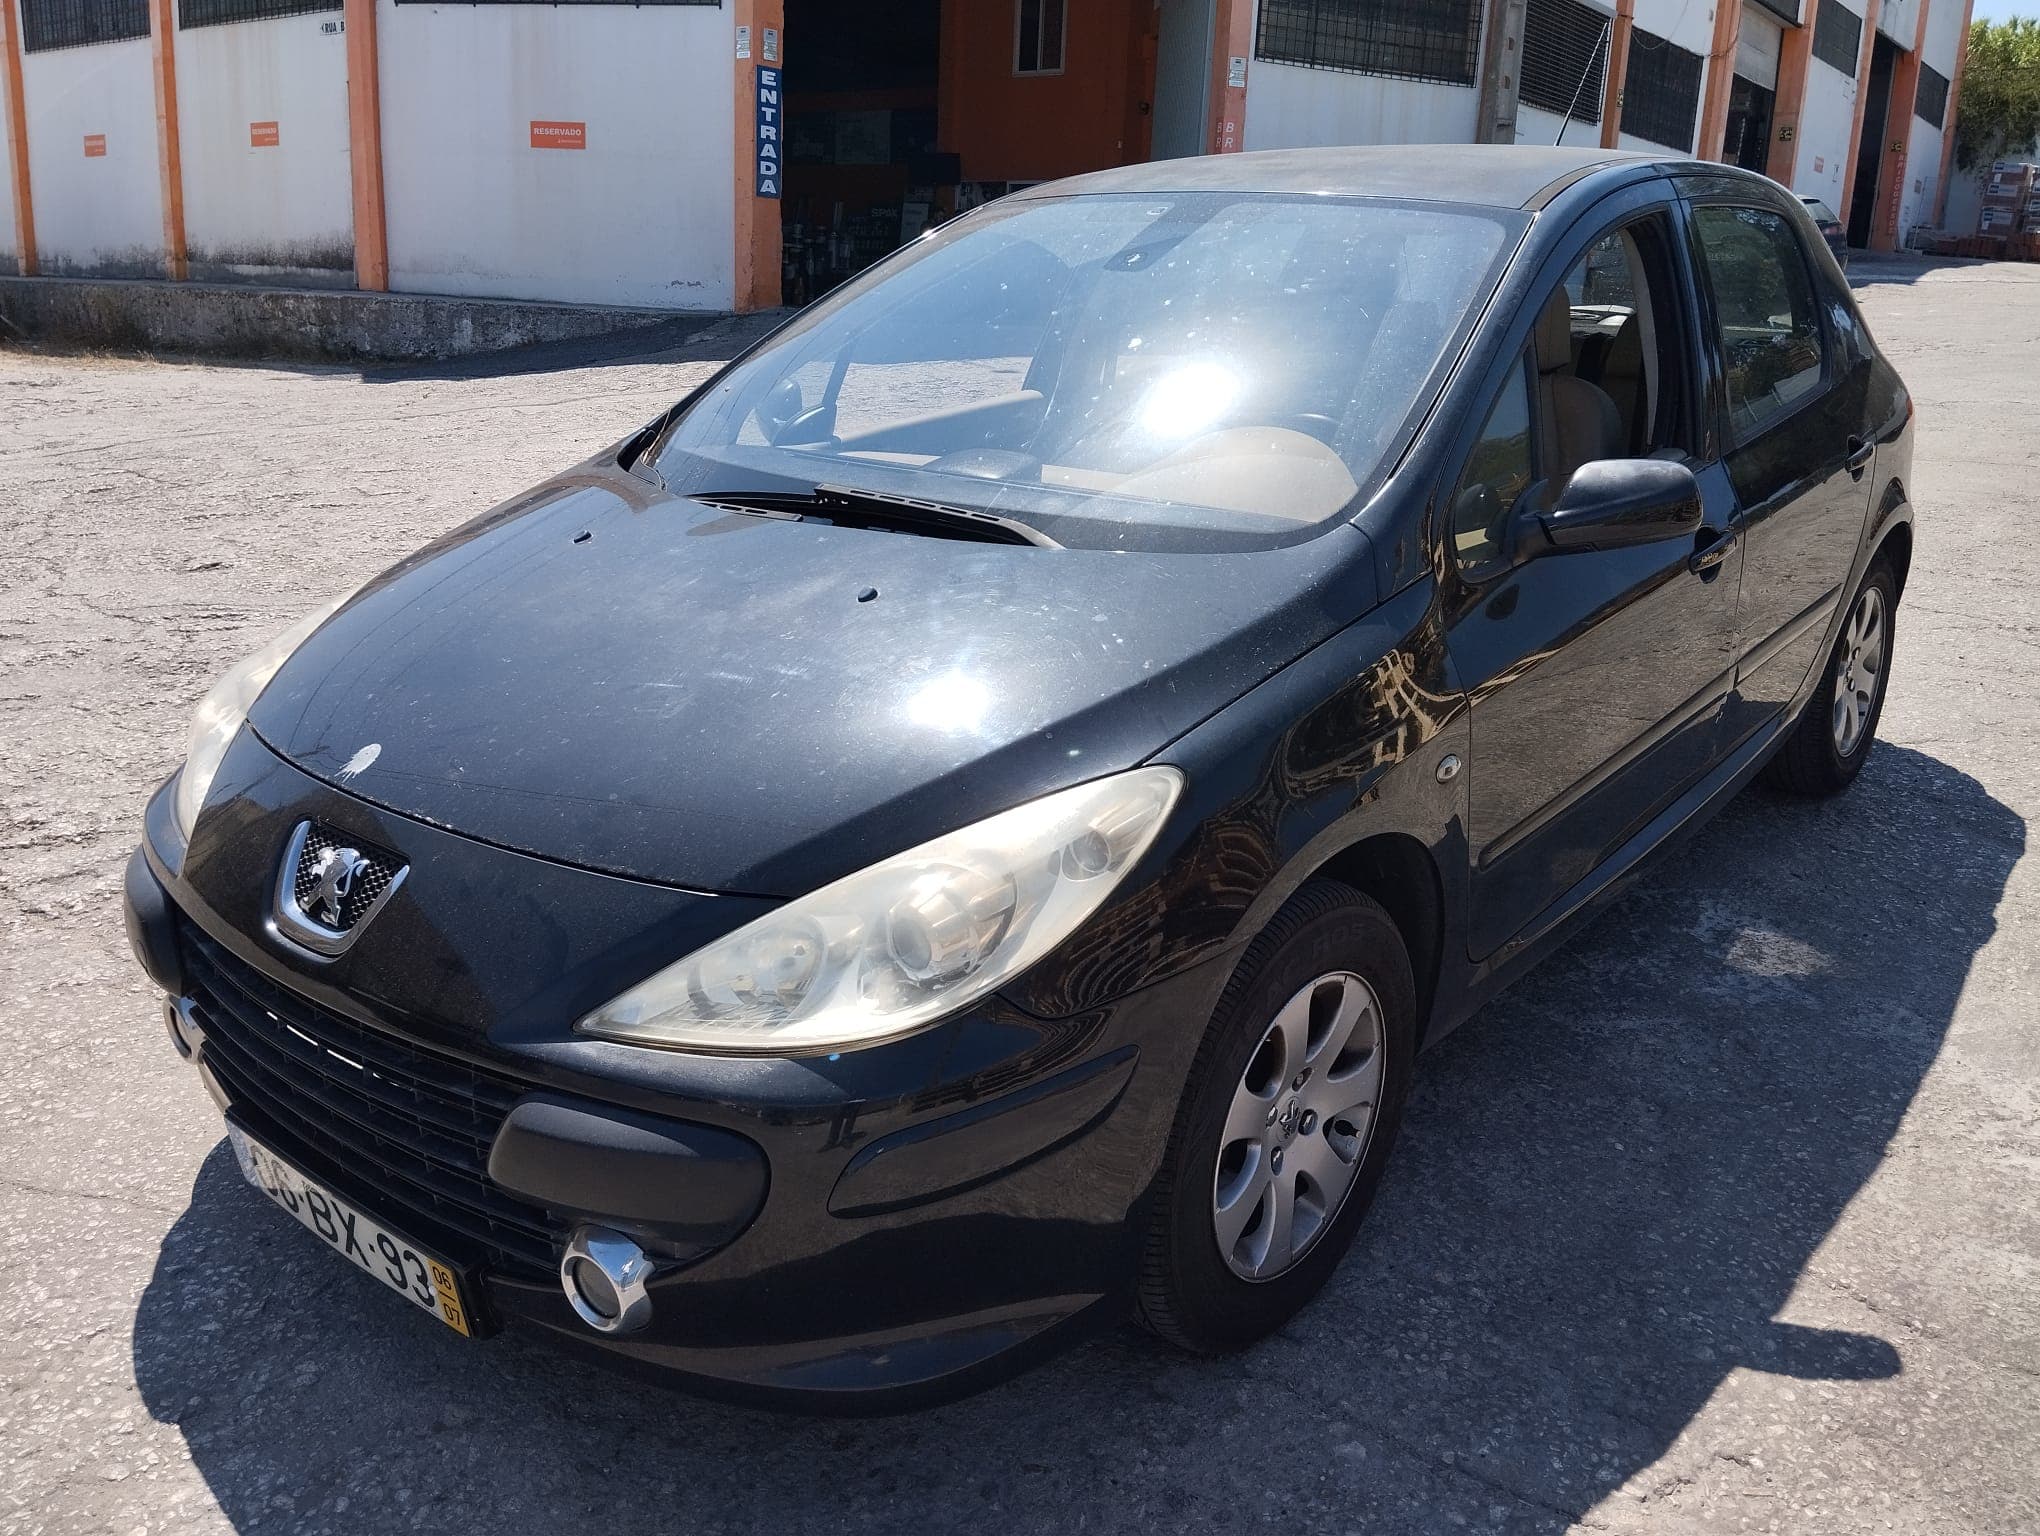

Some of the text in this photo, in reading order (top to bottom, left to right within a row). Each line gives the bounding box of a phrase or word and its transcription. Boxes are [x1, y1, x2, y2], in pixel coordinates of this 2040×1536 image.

[533, 127, 582, 136] RESERVADO
[760, 70, 777, 193] ENTRADA
[432, 1266, 452, 1290] 06
[442, 1303, 460, 1326] 07
